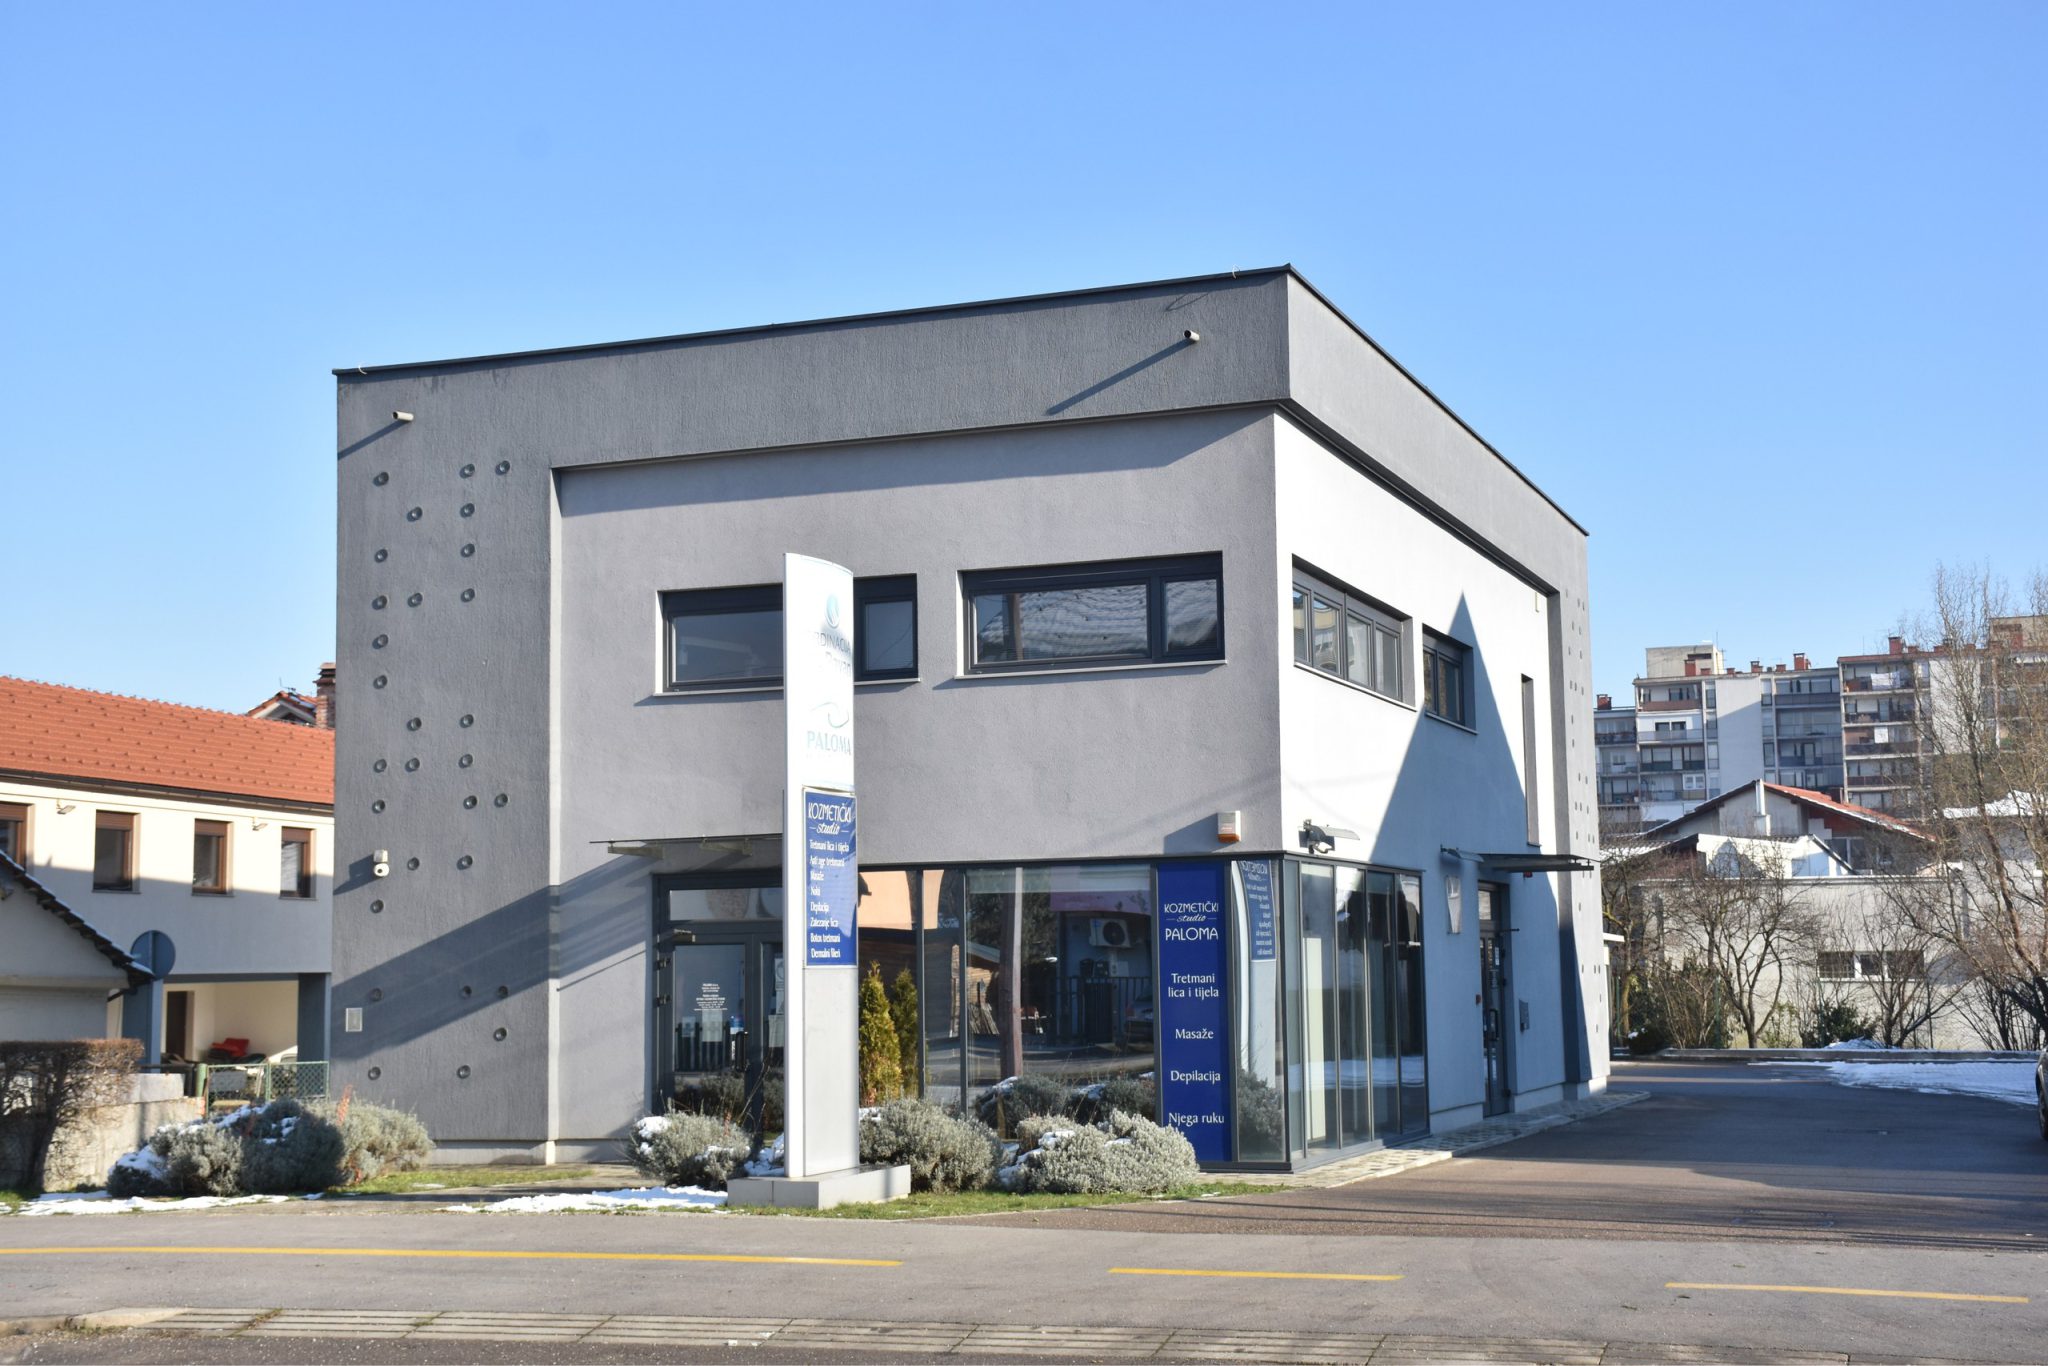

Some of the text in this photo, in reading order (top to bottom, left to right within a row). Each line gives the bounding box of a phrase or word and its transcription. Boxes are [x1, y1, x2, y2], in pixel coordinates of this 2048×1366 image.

[807, 730, 851, 756] PALOMA
[808, 802, 852, 823] KOZMETIČKI
[816, 822, 840, 835] studio
[1164, 901, 1219, 913] KOZMETIČKI
[1177, 914, 1206, 922] studio
[1165, 927, 1219, 941] PALOMA
[1171, 973, 1215, 984] Tretmani
[1168, 986, 1219, 1001] lica i tijela
[1175, 1028, 1214, 1039] Masaže
[1170, 1070, 1221, 1084] Depilacija
[1168, 1112, 1225, 1126] Njega ruku
